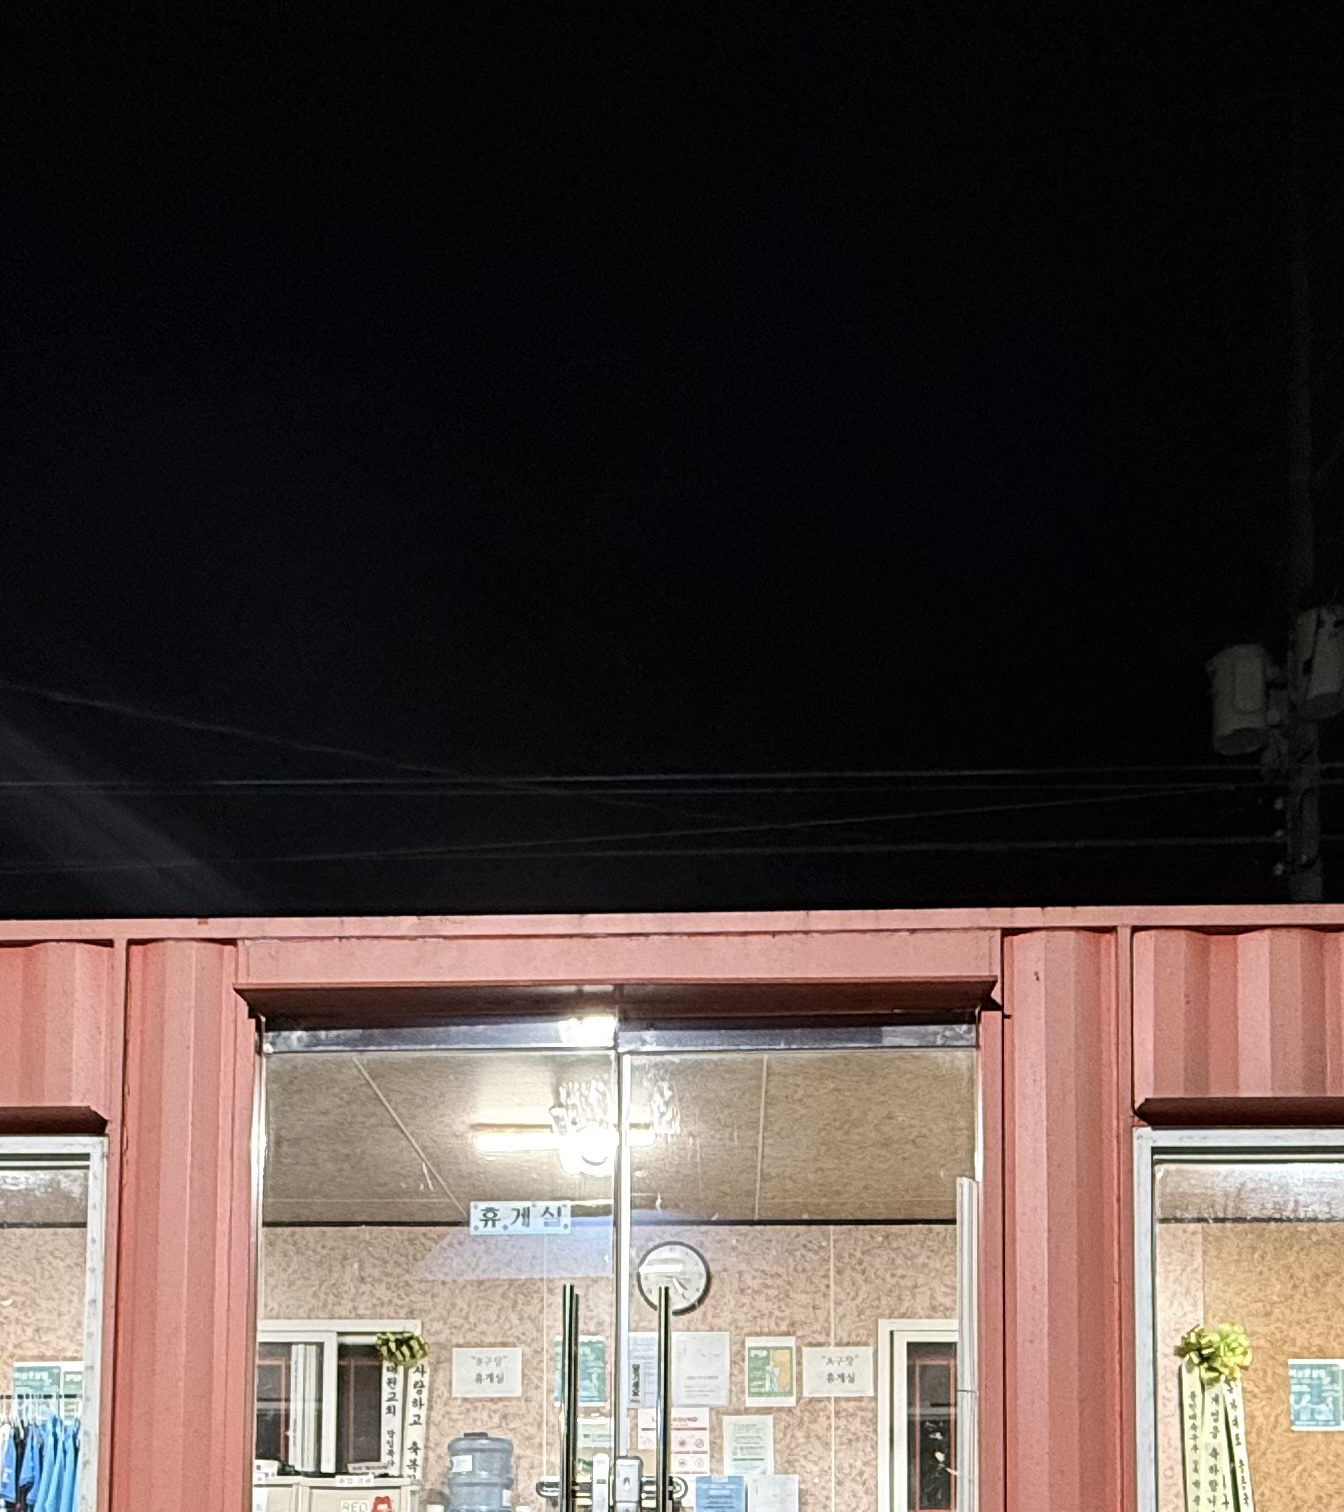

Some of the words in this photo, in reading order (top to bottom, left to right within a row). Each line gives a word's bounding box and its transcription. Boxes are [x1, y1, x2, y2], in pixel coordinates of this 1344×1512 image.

[479, 1206, 562, 1228] 휴게실
[475, 1372, 505, 1384] 휴게실
[826, 1372, 855, 1384] 휴게실
[408, 1364, 427, 1426] 사랑하고
[342, 1502, 368, 1512] RED
